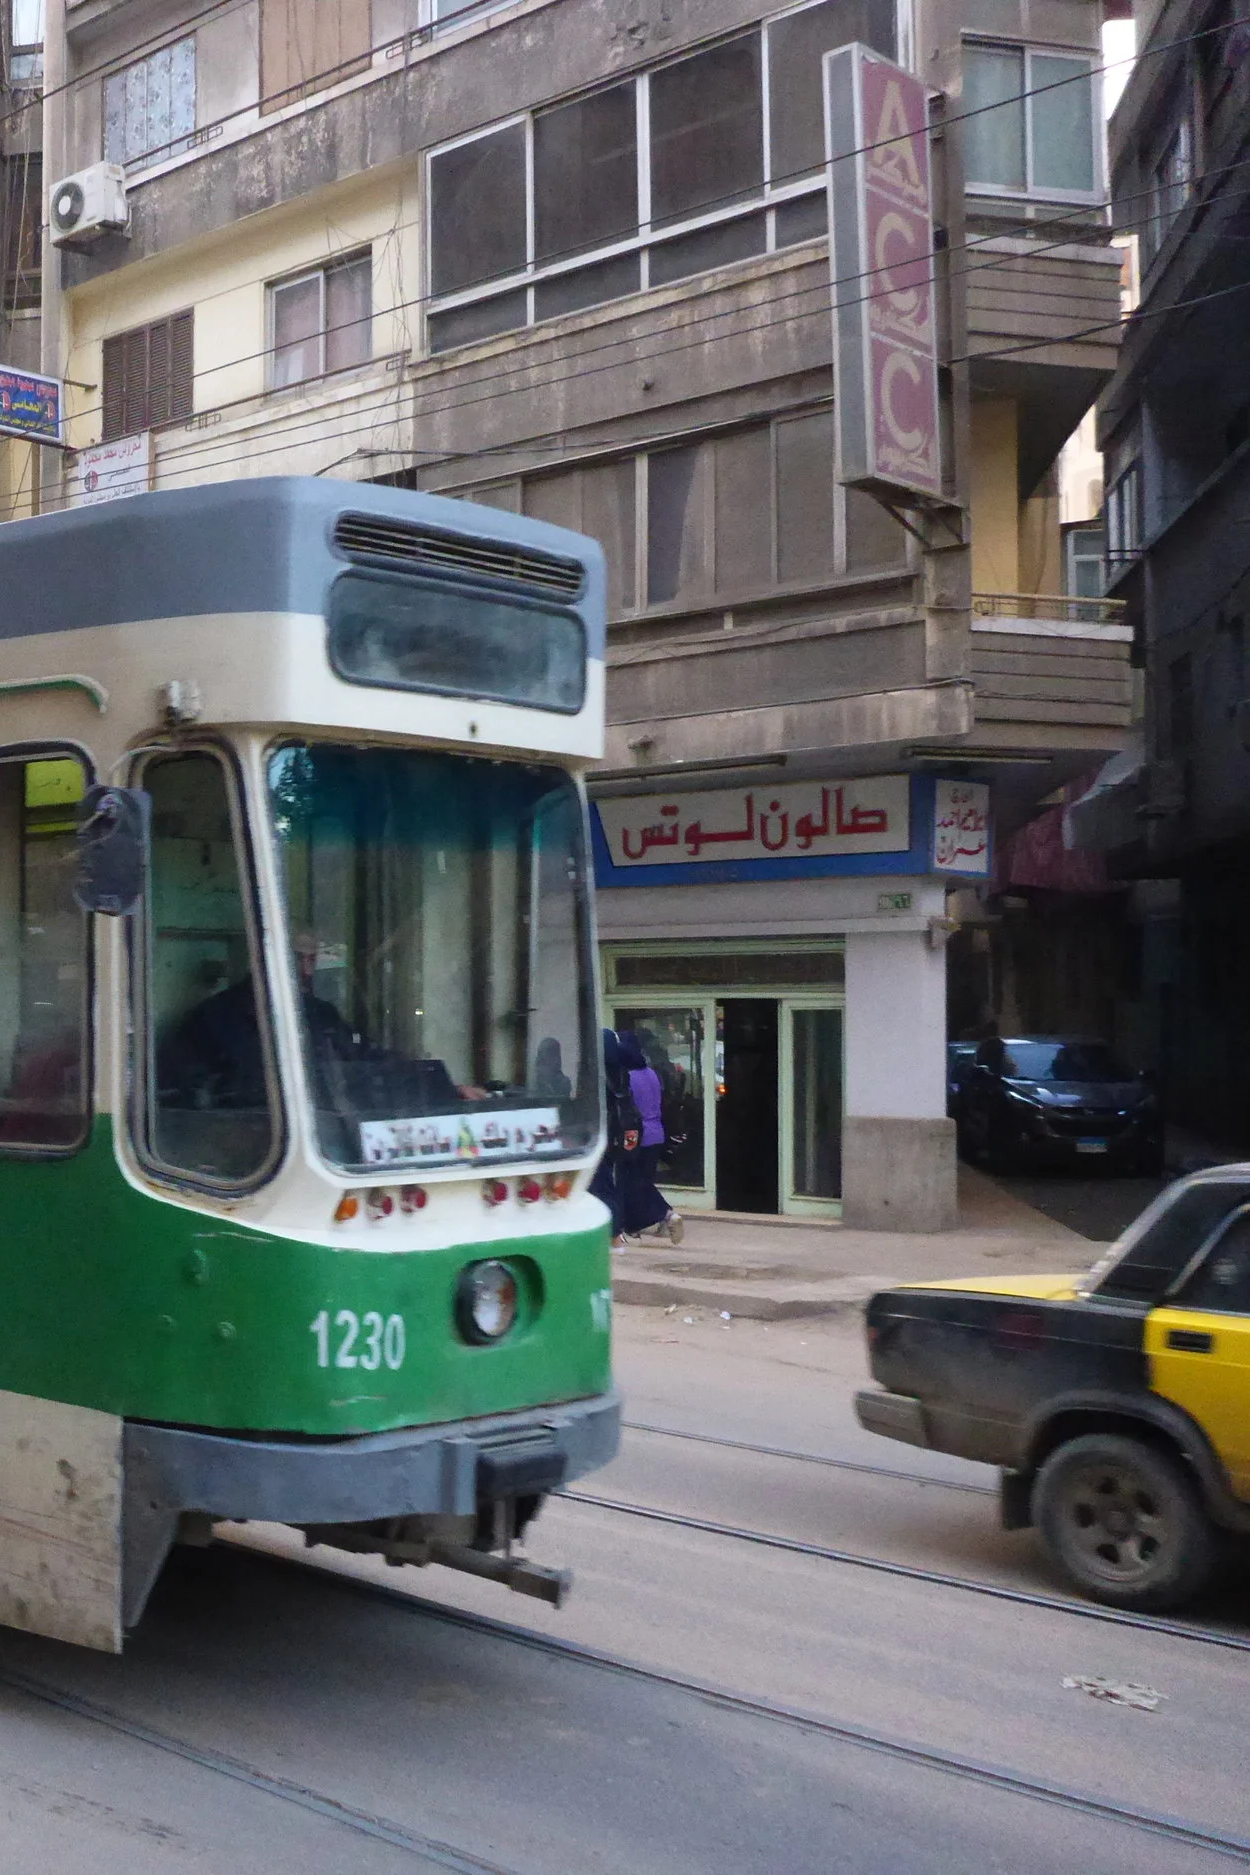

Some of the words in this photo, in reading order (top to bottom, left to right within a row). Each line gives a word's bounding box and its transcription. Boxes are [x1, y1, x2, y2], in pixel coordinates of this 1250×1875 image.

[622, 792, 754, 860] لوتس
[761, 785, 888, 851] صالون
[309, 1309, 407, 1370] 1230
